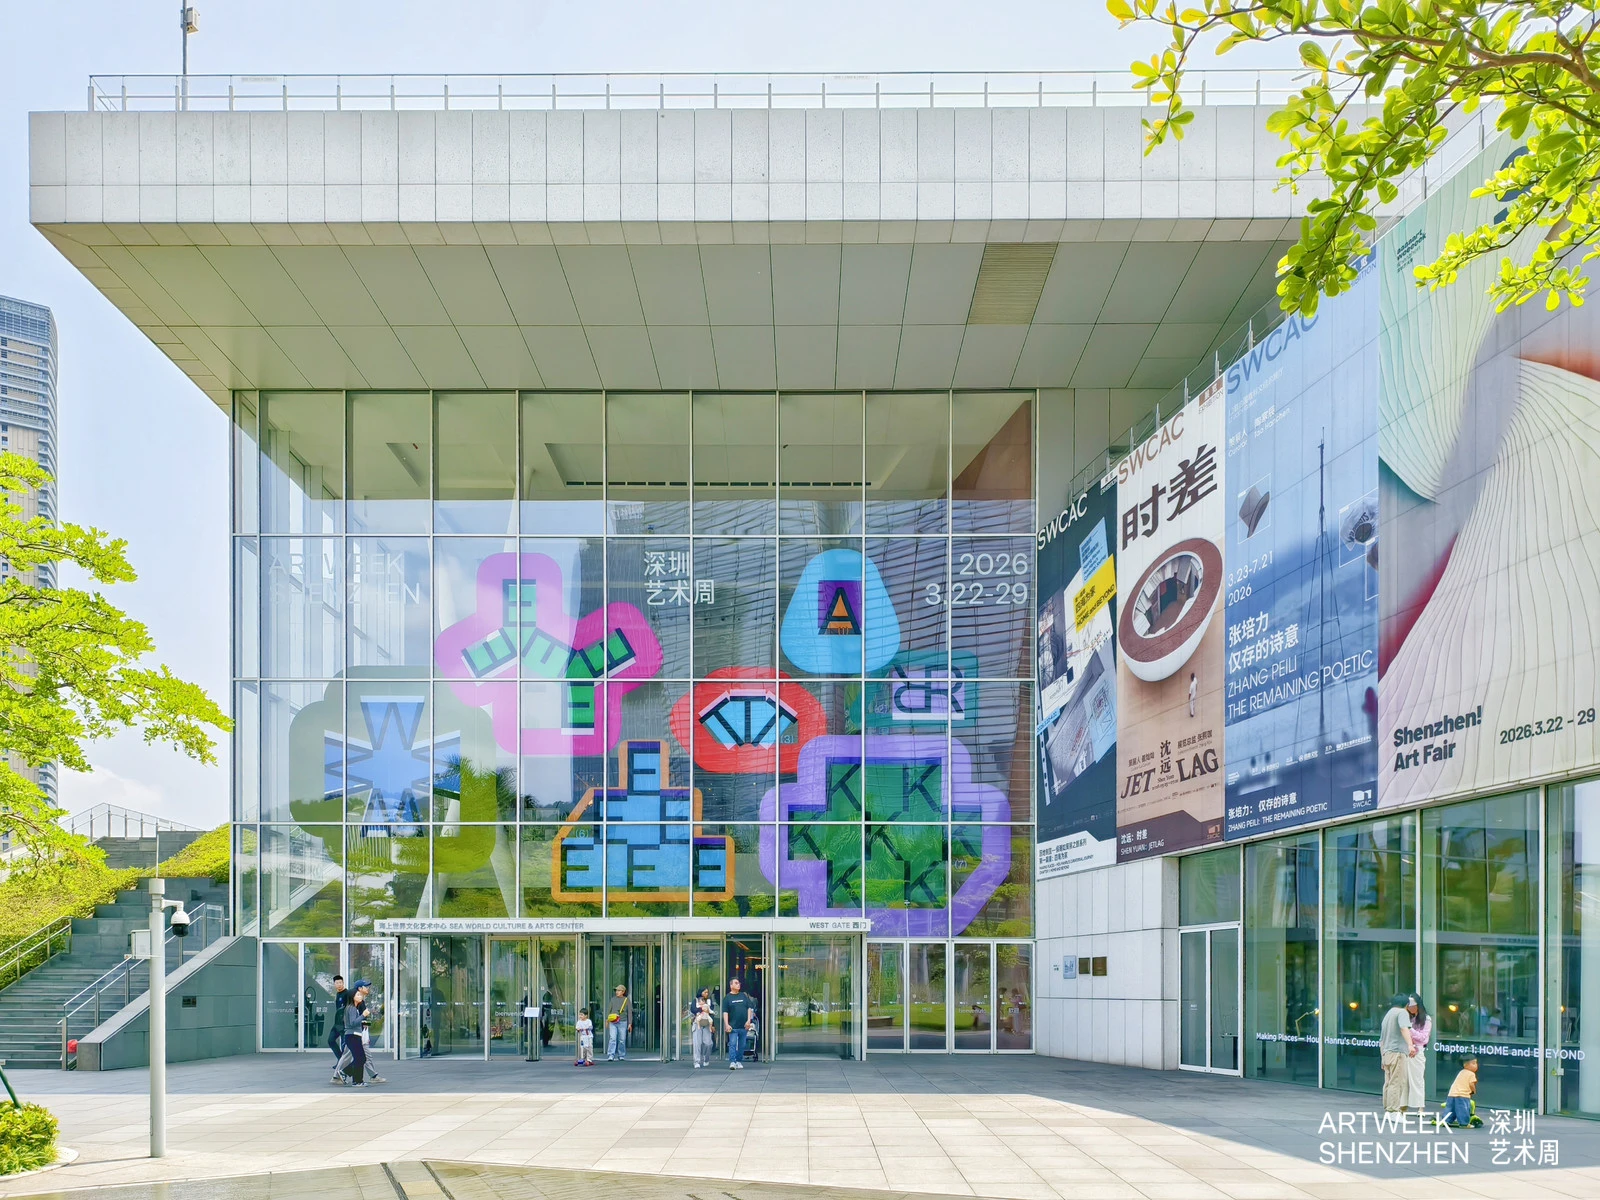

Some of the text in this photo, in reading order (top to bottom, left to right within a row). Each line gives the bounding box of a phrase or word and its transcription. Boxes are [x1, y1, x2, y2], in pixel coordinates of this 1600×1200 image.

[1118, 412, 1184, 485] SWCAC
[1122, 443, 1218, 551] 时差
[1038, 493, 1088, 551] SWCAC
[269, 552, 405, 575] ARWEEK
[643, 551, 690, 577] 深圳
[960, 553, 1028, 575] 2026
[1228, 550, 1273, 587] 3.23-7.21
[644, 579, 715, 606] 艺术周
[925, 582, 1028, 605] 3.22-29
[1228, 583, 1252, 607] 2026
[1229, 611, 1270, 648] 张培力
[1228, 623, 1300, 675] 仅存的诗意
[1228, 655, 1297, 699] ZHANG PEILI
[1228, 650, 1373, 719] THE REMAINING POETIC
[1393, 705, 1482, 748] Shenzhen!
[1499, 716, 1563, 745] 2026.3.22
[1577, 708, 1596, 726] 29
[1160, 740, 1171, 775] 沈远
[1393, 739, 1456, 772] Art Fair
[1120, 767, 1156, 799] JET
[1175, 748, 1219, 782] LAG
[1228, 822, 1246, 833] ZHANG
[1262, 814, 1273, 824] THE
[1273, 807, 1305, 821] REMAINING
[1306, 802, 1328, 814] POETIC
[1352, 800, 1372, 809] SWCAC
[575, 829, 590, 838] (6)
[1120, 846, 1132, 855] SHEN
[1147, 839, 1165, 851] JETLAG
[449, 922, 464, 930] SEA
[465, 922, 491, 930] WORLD
[492, 922, 527, 930] CULTURE
[528, 922, 534, 930] &
[535, 922, 554, 930] ARTS
[555, 922, 584, 930] CENTER
[852, 921, 867, 929] 西门
[1256, 1032, 1277, 1042] Making
[1306, 1035, 1320, 1044] Hou
[1324, 1036, 1350, 1046] Hanru's
[1433, 1042, 1468, 1053] Chapter
[1471, 1045, 1478, 1053] 1:
[1479, 1045, 1509, 1056] HOME
[1511, 1046, 1530, 1057] and
